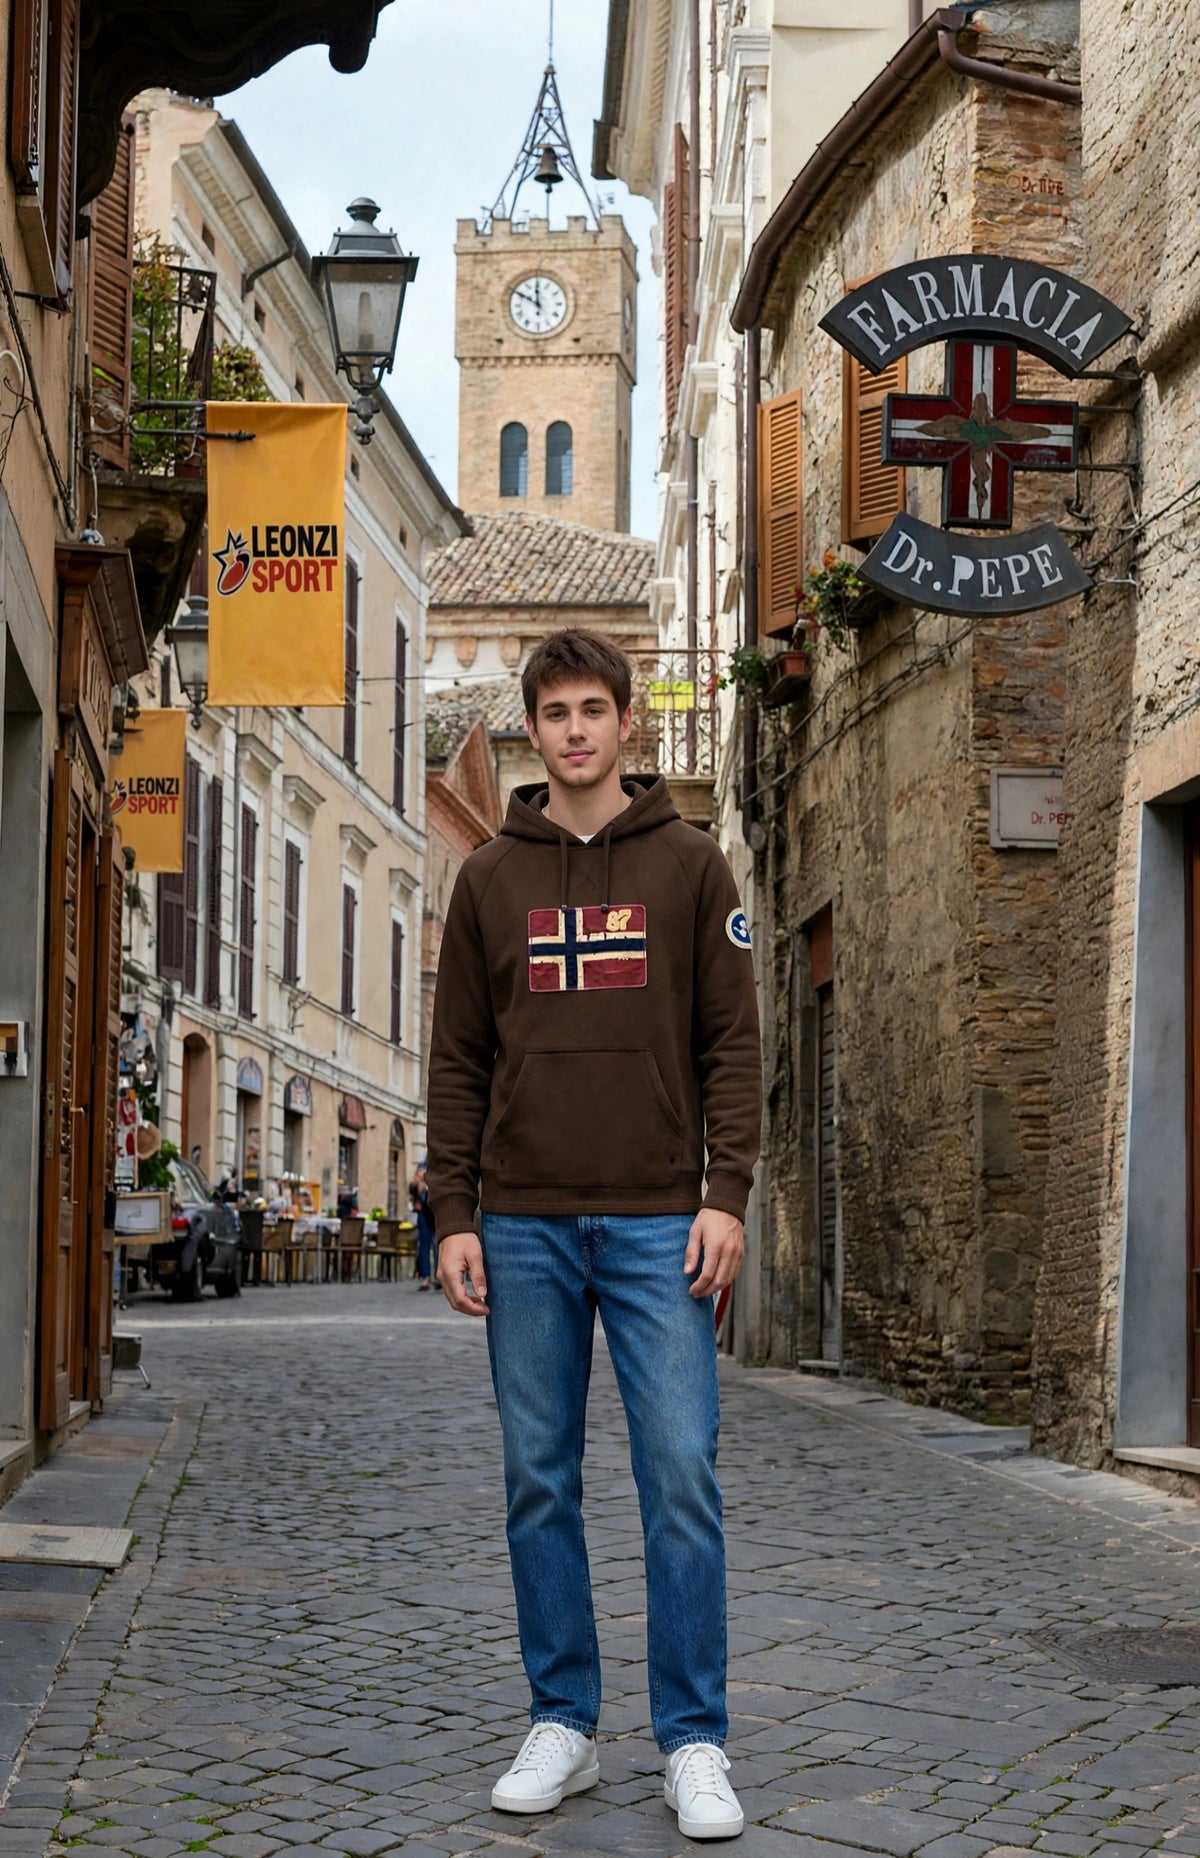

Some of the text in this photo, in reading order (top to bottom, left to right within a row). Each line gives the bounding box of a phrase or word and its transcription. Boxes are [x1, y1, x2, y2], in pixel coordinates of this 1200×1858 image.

[846, 263, 1104, 361] FARMACIA
[251, 524, 338, 558] LEONZI
[251, 558, 338, 593] SPORT
[128, 777, 179, 796] LEONZI
[127, 795, 179, 815] SPORT
[605, 908, 632, 932] 87
